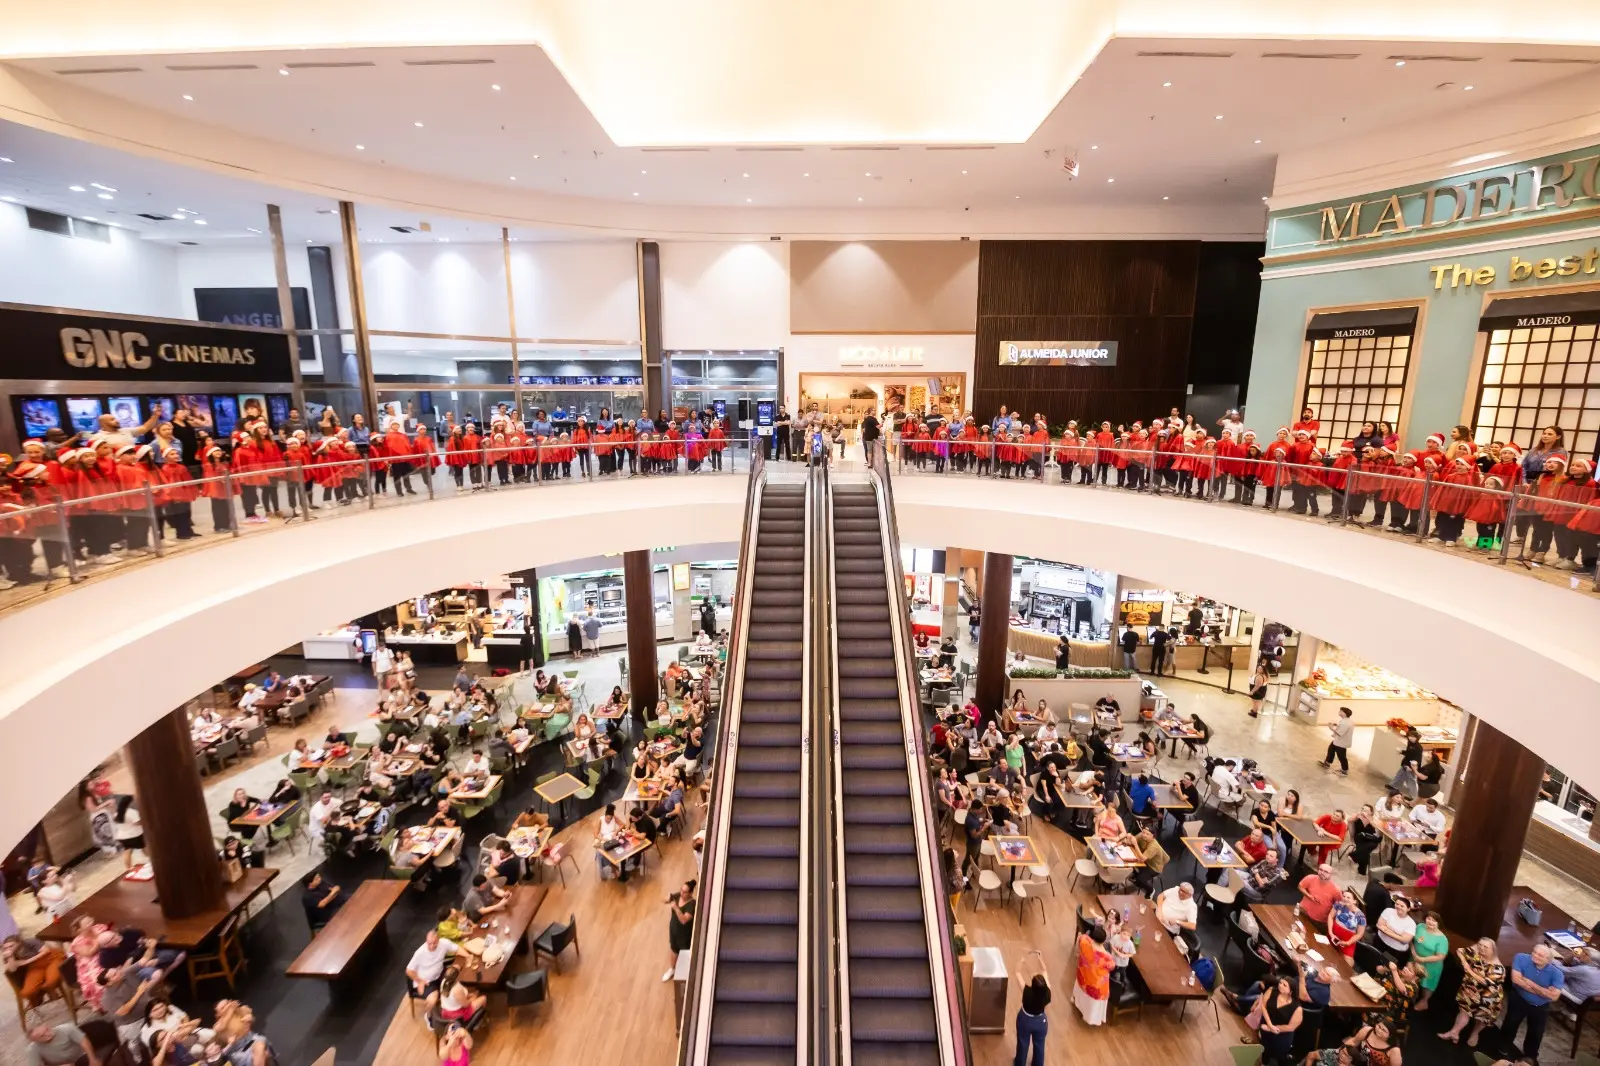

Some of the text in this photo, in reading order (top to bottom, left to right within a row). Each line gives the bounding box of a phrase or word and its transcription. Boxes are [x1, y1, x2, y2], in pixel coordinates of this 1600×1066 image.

[1430, 247, 1600, 289] The best
[1515, 315, 1572, 327] MADERO
[1333, 328, 1376, 338] MADERO
[60, 327, 256, 370] GNC CINEMAS
[1020, 348, 1109, 359] ALMEIDA JUNIOR
